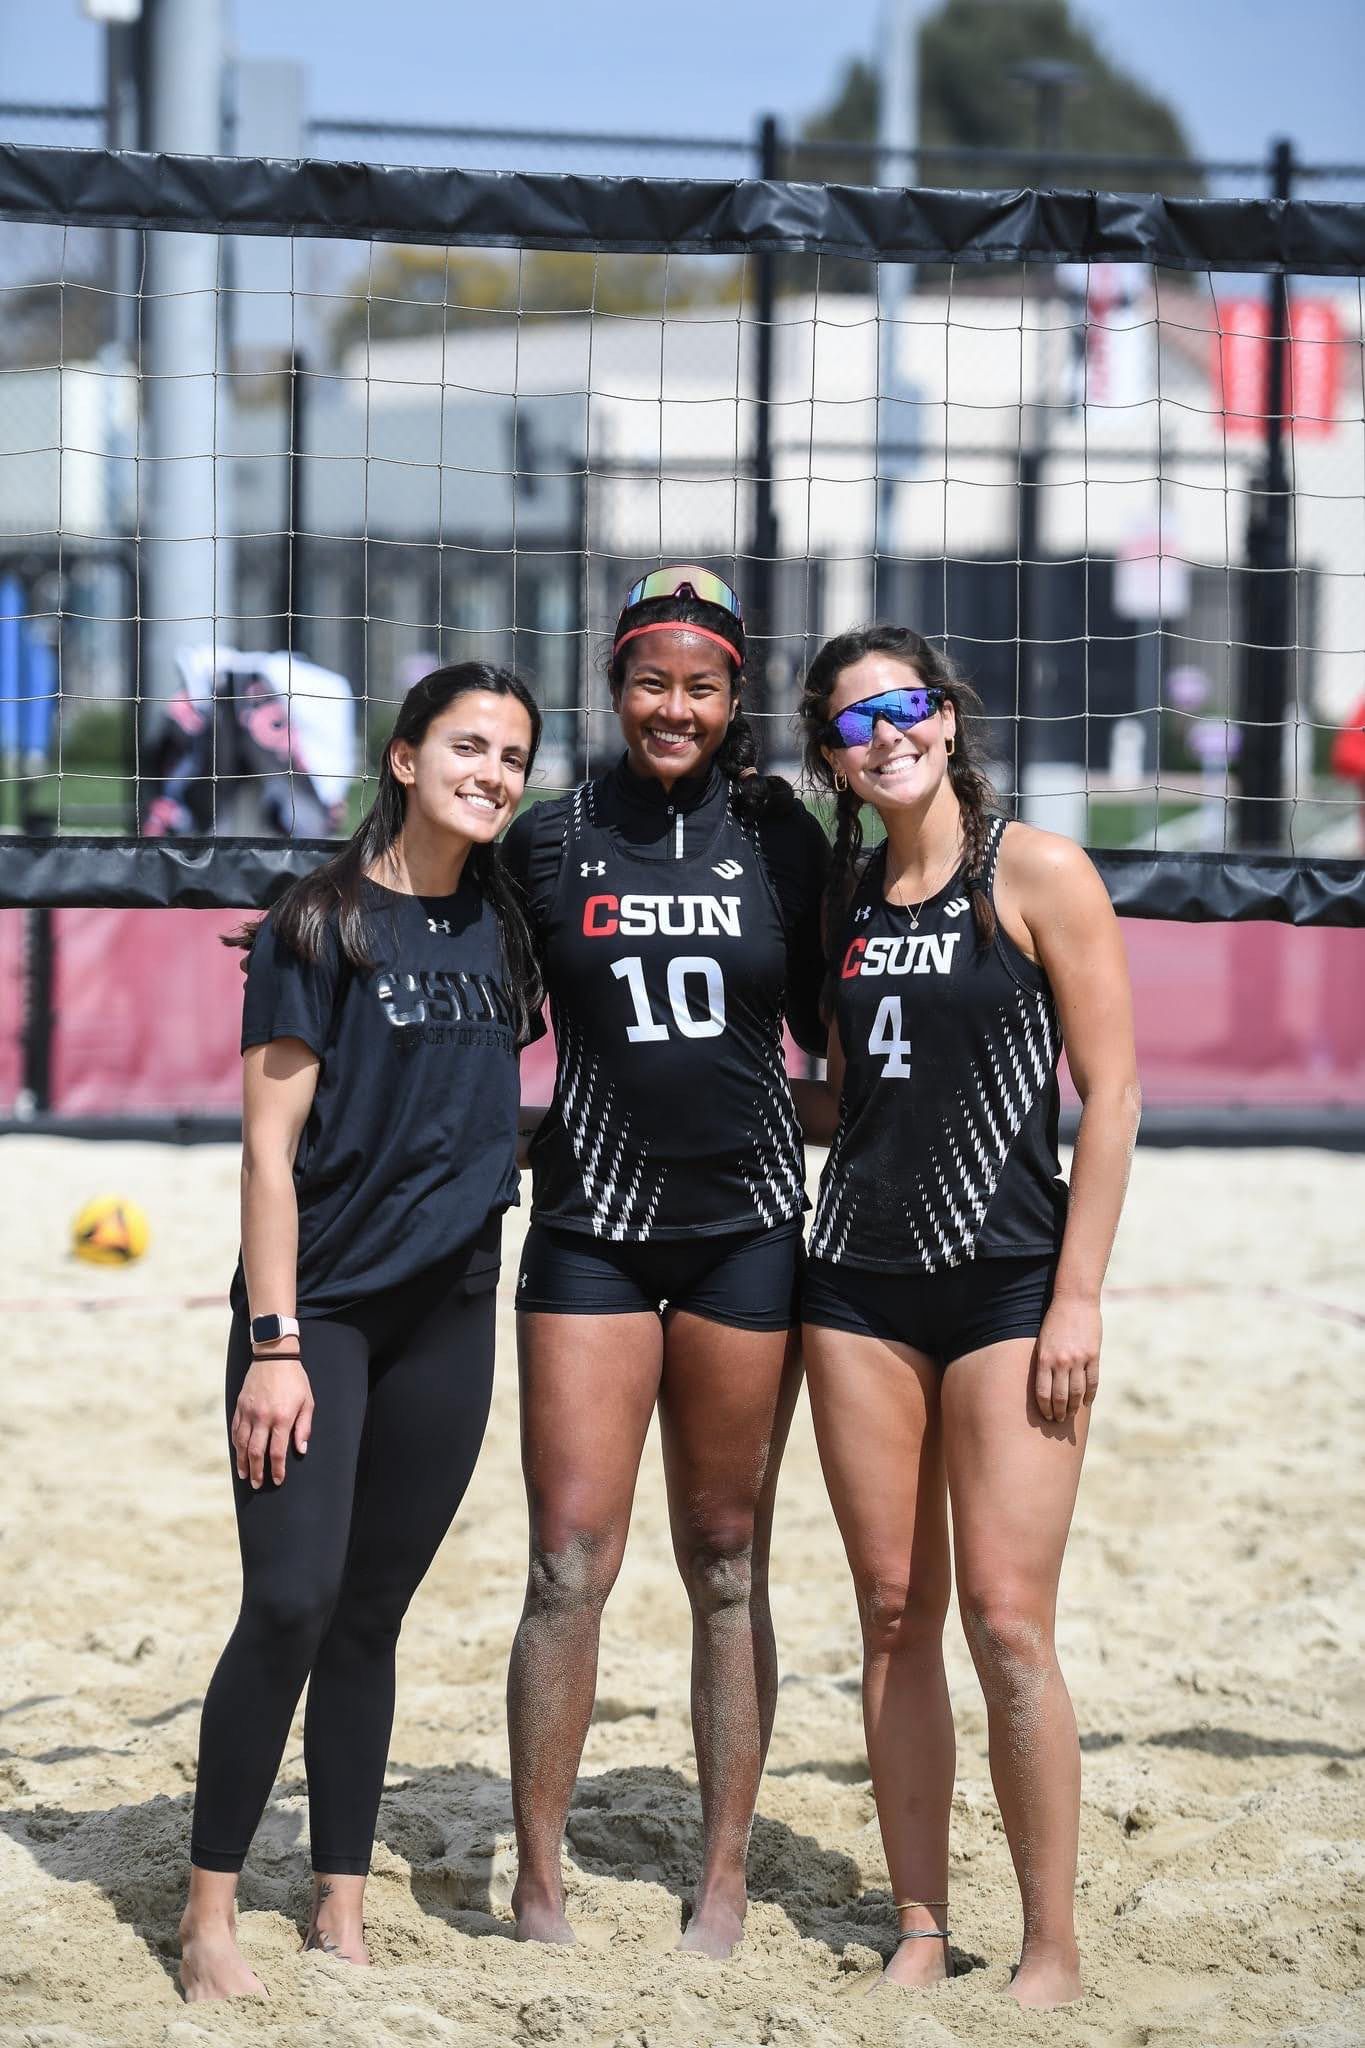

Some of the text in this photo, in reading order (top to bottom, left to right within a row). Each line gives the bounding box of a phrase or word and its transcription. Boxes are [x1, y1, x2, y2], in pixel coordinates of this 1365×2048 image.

[582, 894, 742, 937] CSUN
[840, 932, 961, 980] CSUN
[377, 971, 517, 1027] CSUN
[610, 956, 727, 1043] 10
[868, 996, 912, 1079] 4
